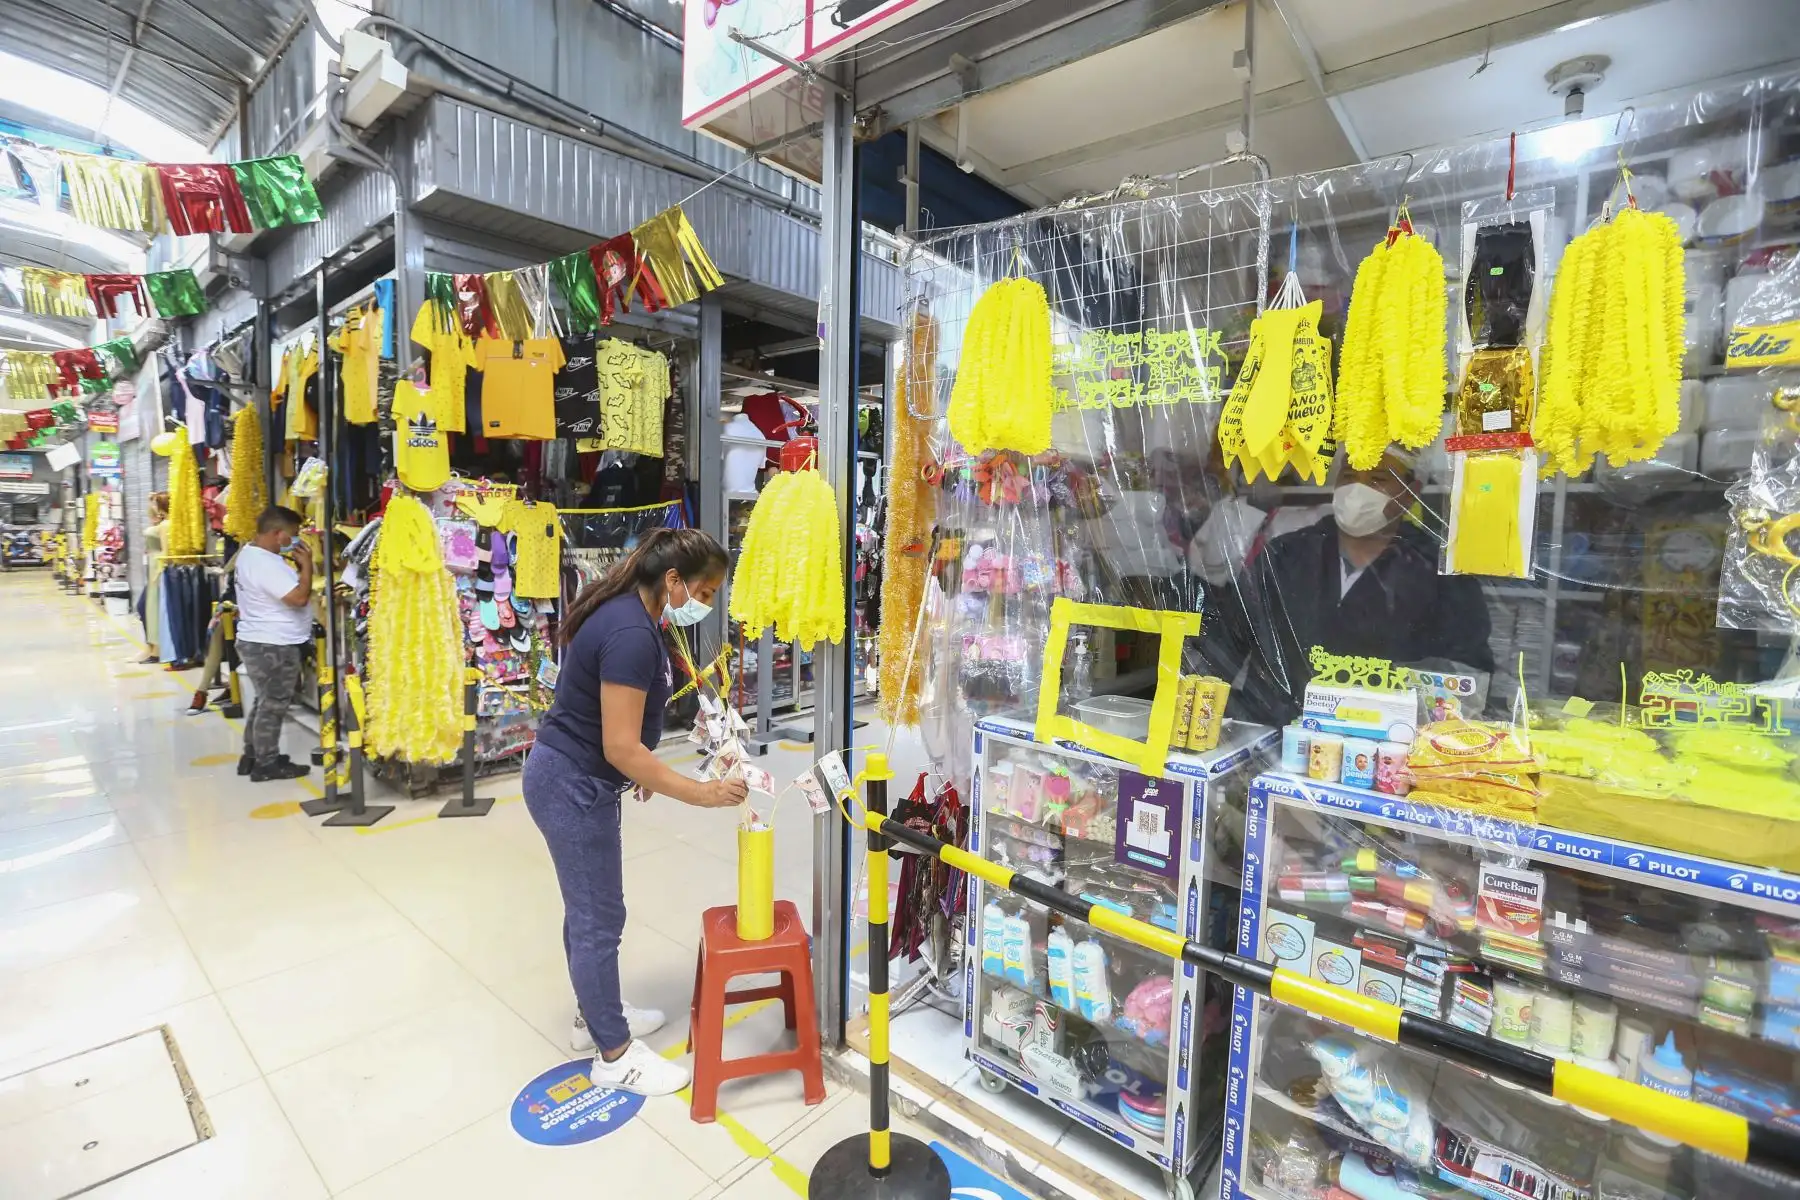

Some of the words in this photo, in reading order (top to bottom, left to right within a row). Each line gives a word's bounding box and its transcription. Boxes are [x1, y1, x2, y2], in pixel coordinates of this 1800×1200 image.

[1290, 393, 1317, 408] AÑO
[1286, 404, 1325, 421] NUEVO
[1404, 670, 1472, 693] LOBOS
[1305, 691, 1342, 711] Family
[1305, 699, 1336, 709] Doctor
[1306, 719, 1317, 728] 50
[1178, 766, 1197, 774] PILOT
[1264, 782, 1297, 796] PILOT
[1327, 794, 1363, 809] PILOT
[1248, 808, 1258, 839] PILOT
[1396, 808, 1435, 825] PILOT
[1555, 841, 1602, 860] PILOT
[1244, 863, 1254, 894] PILOT
[1648, 861, 1701, 880] PILOT
[1485, 875, 1537, 896] CureBand
[1241, 918, 1251, 949] PILOT
[1561, 951, 1584, 962] L.G.M.
[1560, 969, 1583, 980] L.G.M.
[1233, 1024, 1243, 1055] PILOT
[1229, 1077, 1239, 1106] PILOT
[1642, 1075, 1690, 1098] VIKINGO
[539, 1087, 605, 1122] DISTANCIA
[1225, 1127, 1235, 1157] PILOT
[1223, 1177, 1232, 1200] PILO
